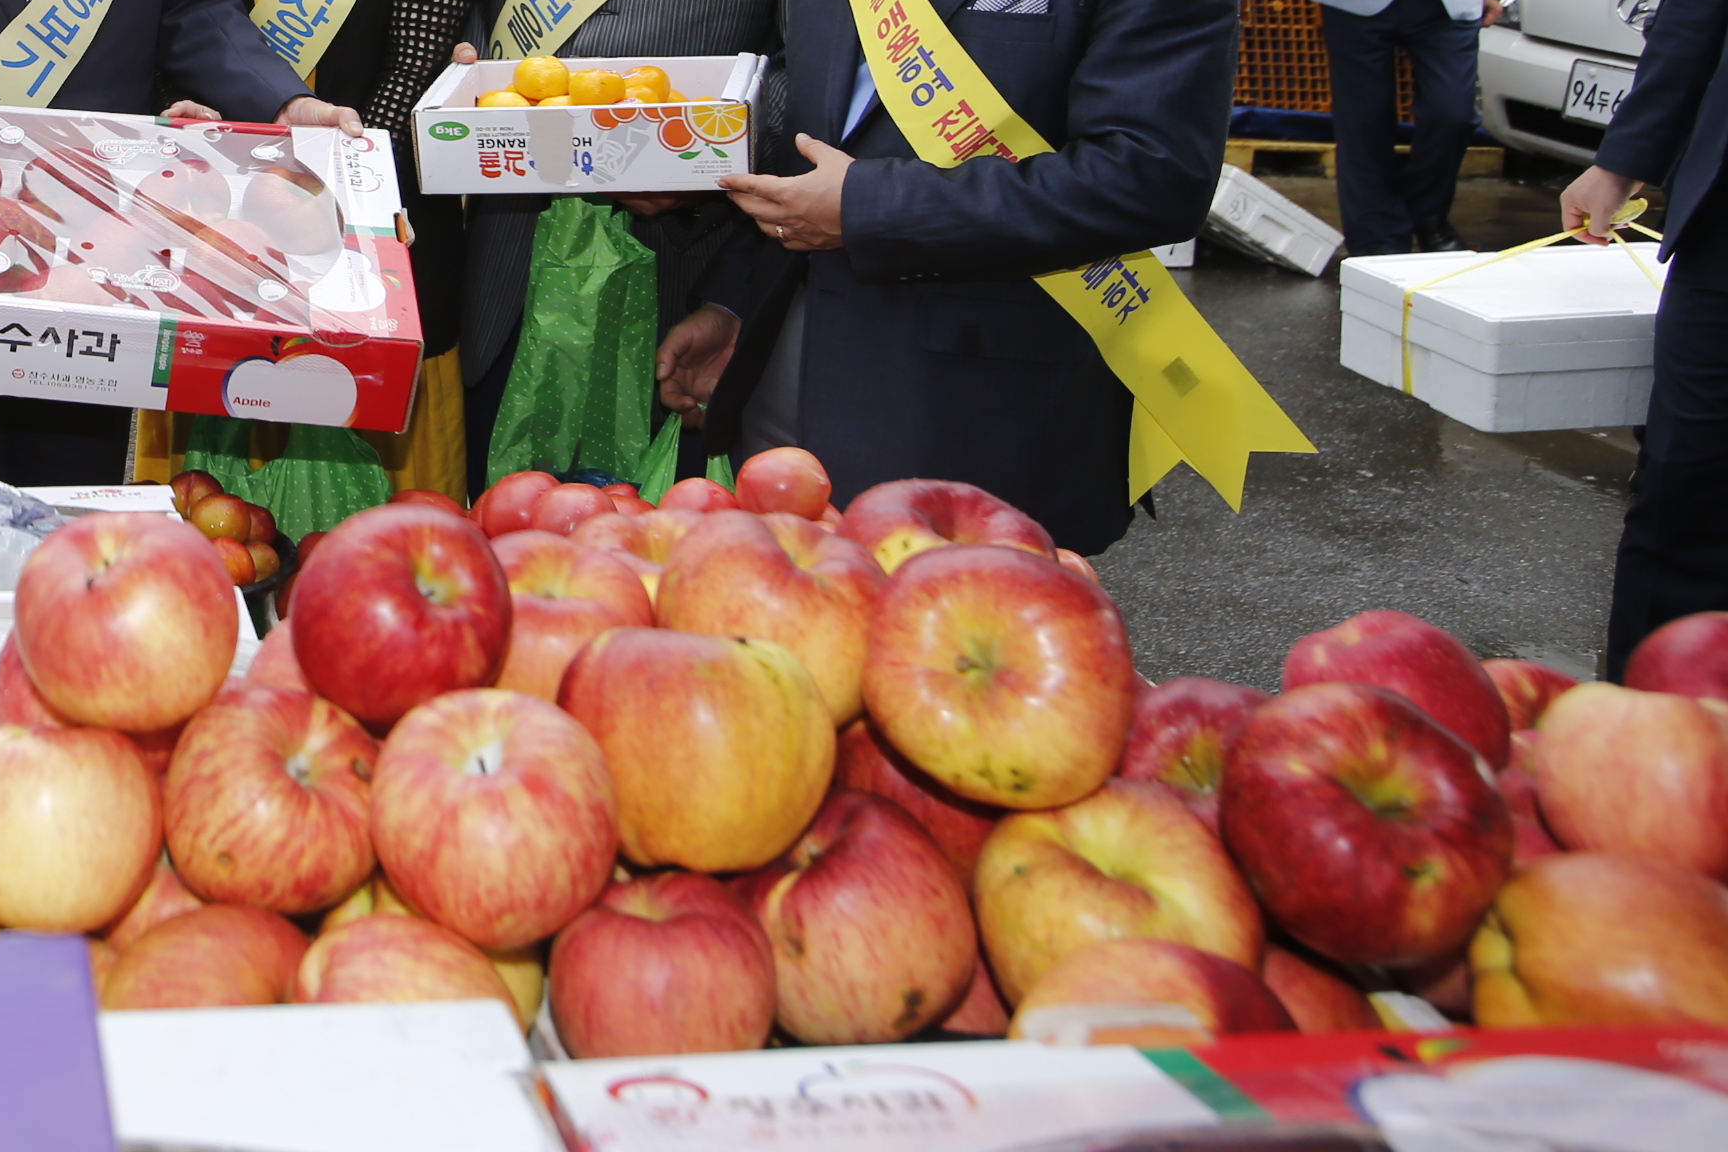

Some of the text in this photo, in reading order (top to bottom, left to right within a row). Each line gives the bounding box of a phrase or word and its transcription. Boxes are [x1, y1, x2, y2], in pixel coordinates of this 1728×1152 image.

[875, 8, 955, 107] 애용하여
[434, 125, 463, 137] 3kg
[477, 138, 527, 149] RANGE
[28, 369, 71, 383] 장수사과
[232, 396, 271, 408] Apple
